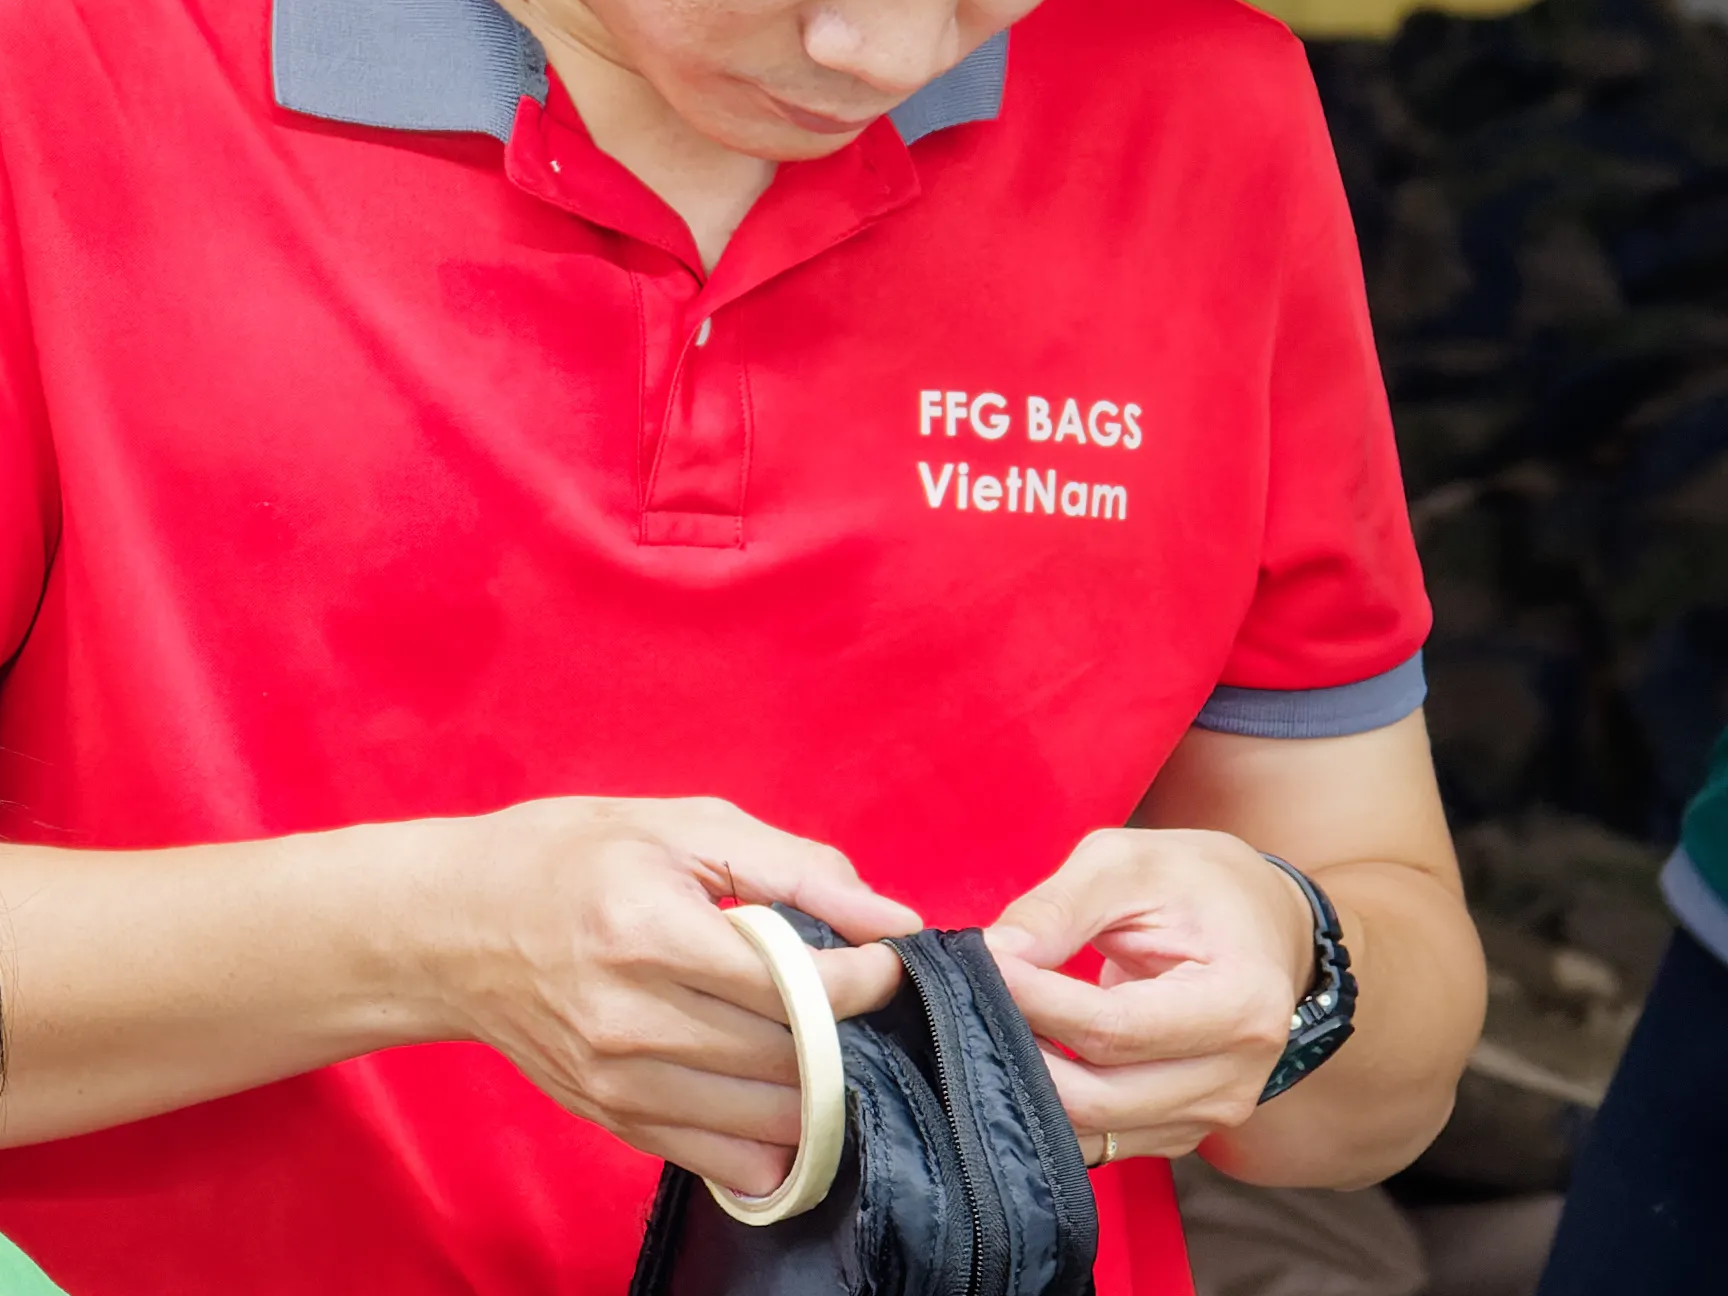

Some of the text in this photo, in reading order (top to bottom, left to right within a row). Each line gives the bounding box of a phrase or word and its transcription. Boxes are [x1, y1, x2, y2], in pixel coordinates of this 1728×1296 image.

[919, 390, 1143, 449] FFG BAGS
[917, 461, 1128, 520] VietNam
